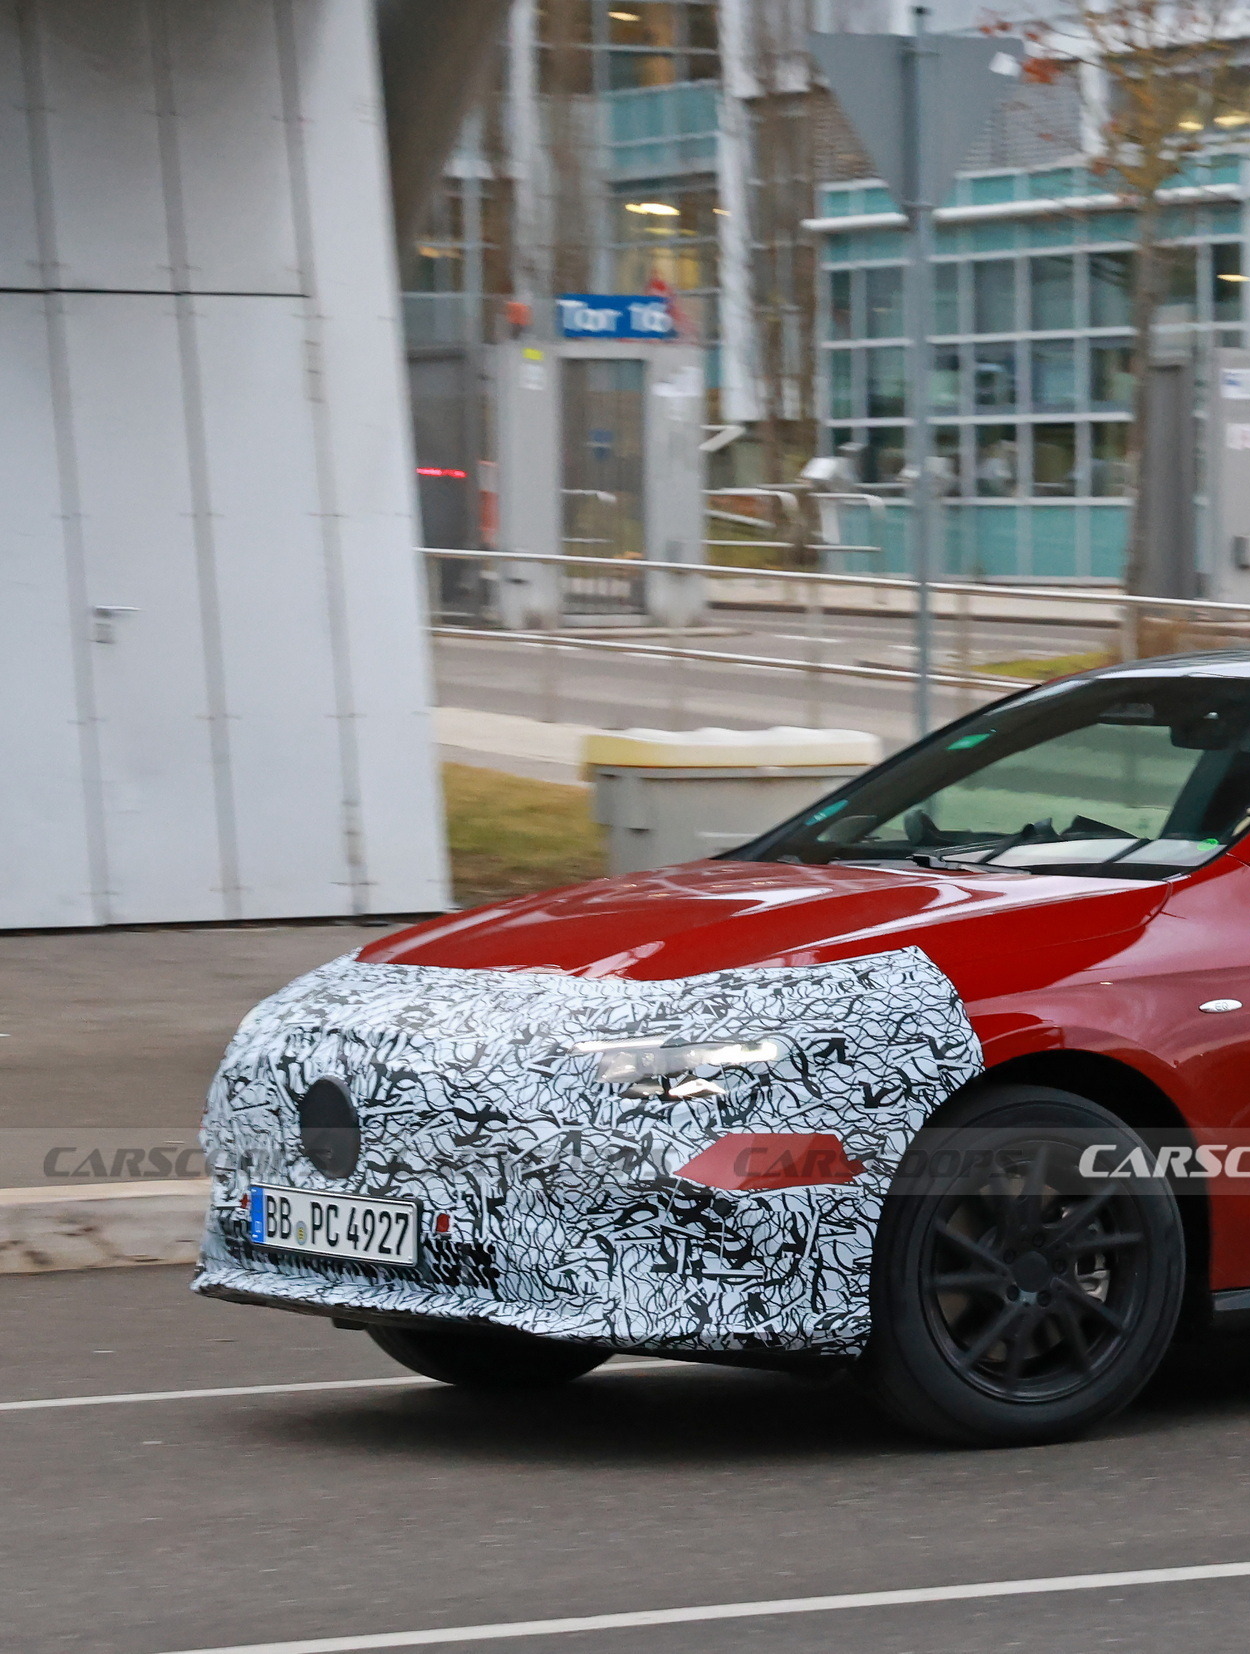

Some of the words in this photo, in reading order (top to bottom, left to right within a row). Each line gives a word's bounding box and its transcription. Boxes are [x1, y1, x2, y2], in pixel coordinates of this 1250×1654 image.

[266, 1195, 292, 1240] BB
[311, 1201, 339, 1247] PC
[347, 1206, 409, 1256] 4927
